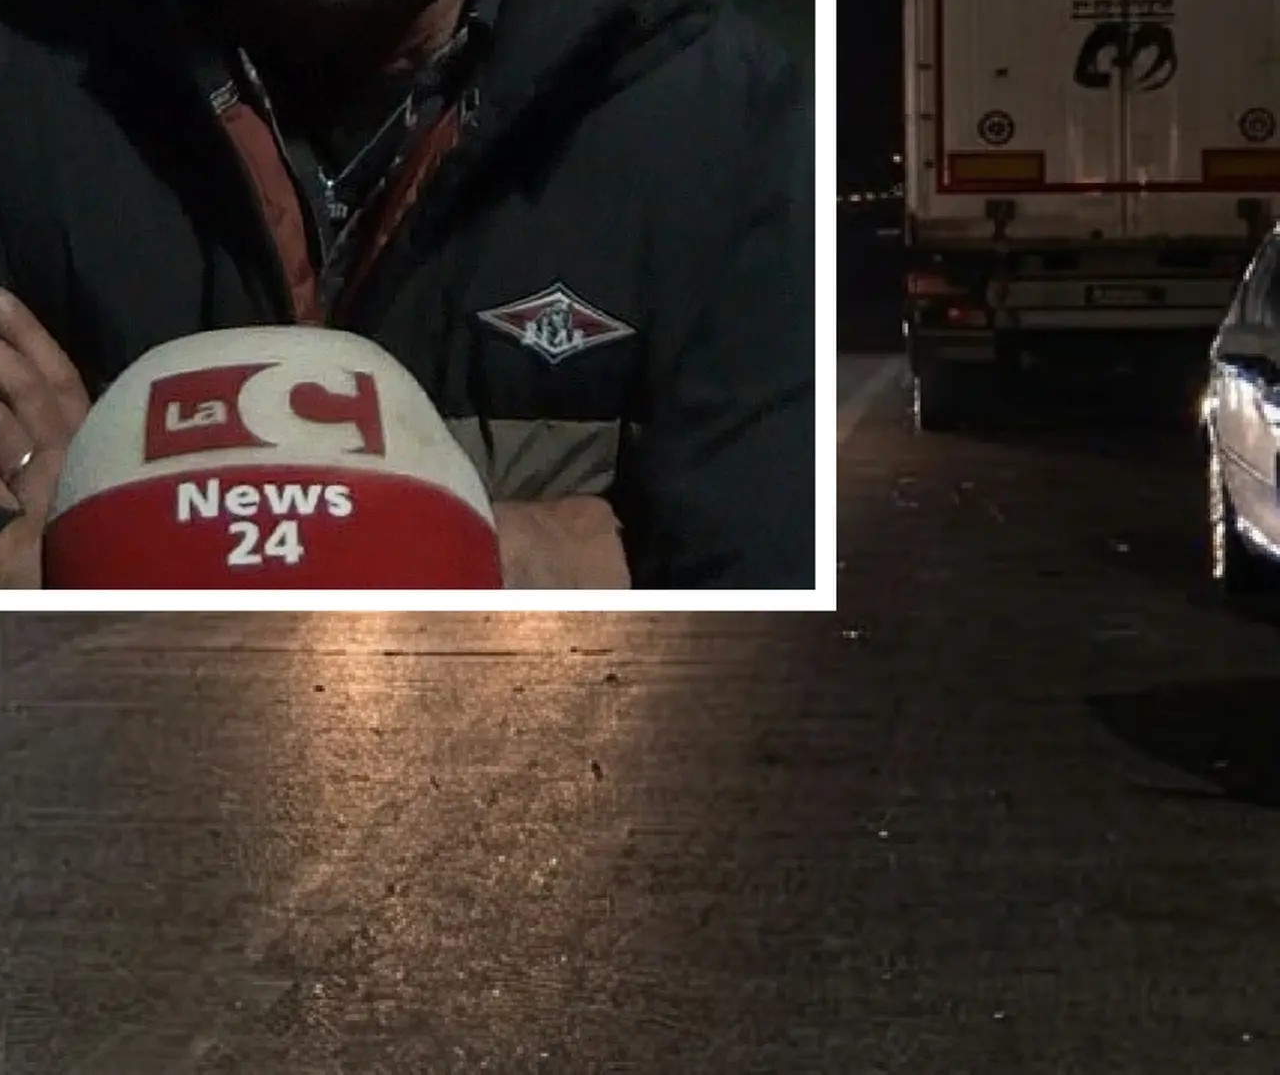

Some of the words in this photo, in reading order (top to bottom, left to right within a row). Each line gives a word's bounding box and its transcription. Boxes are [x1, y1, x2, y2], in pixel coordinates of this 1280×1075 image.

[165, 399, 228, 431] La
[175, 477, 354, 523] News
[225, 519, 306, 567] 24
